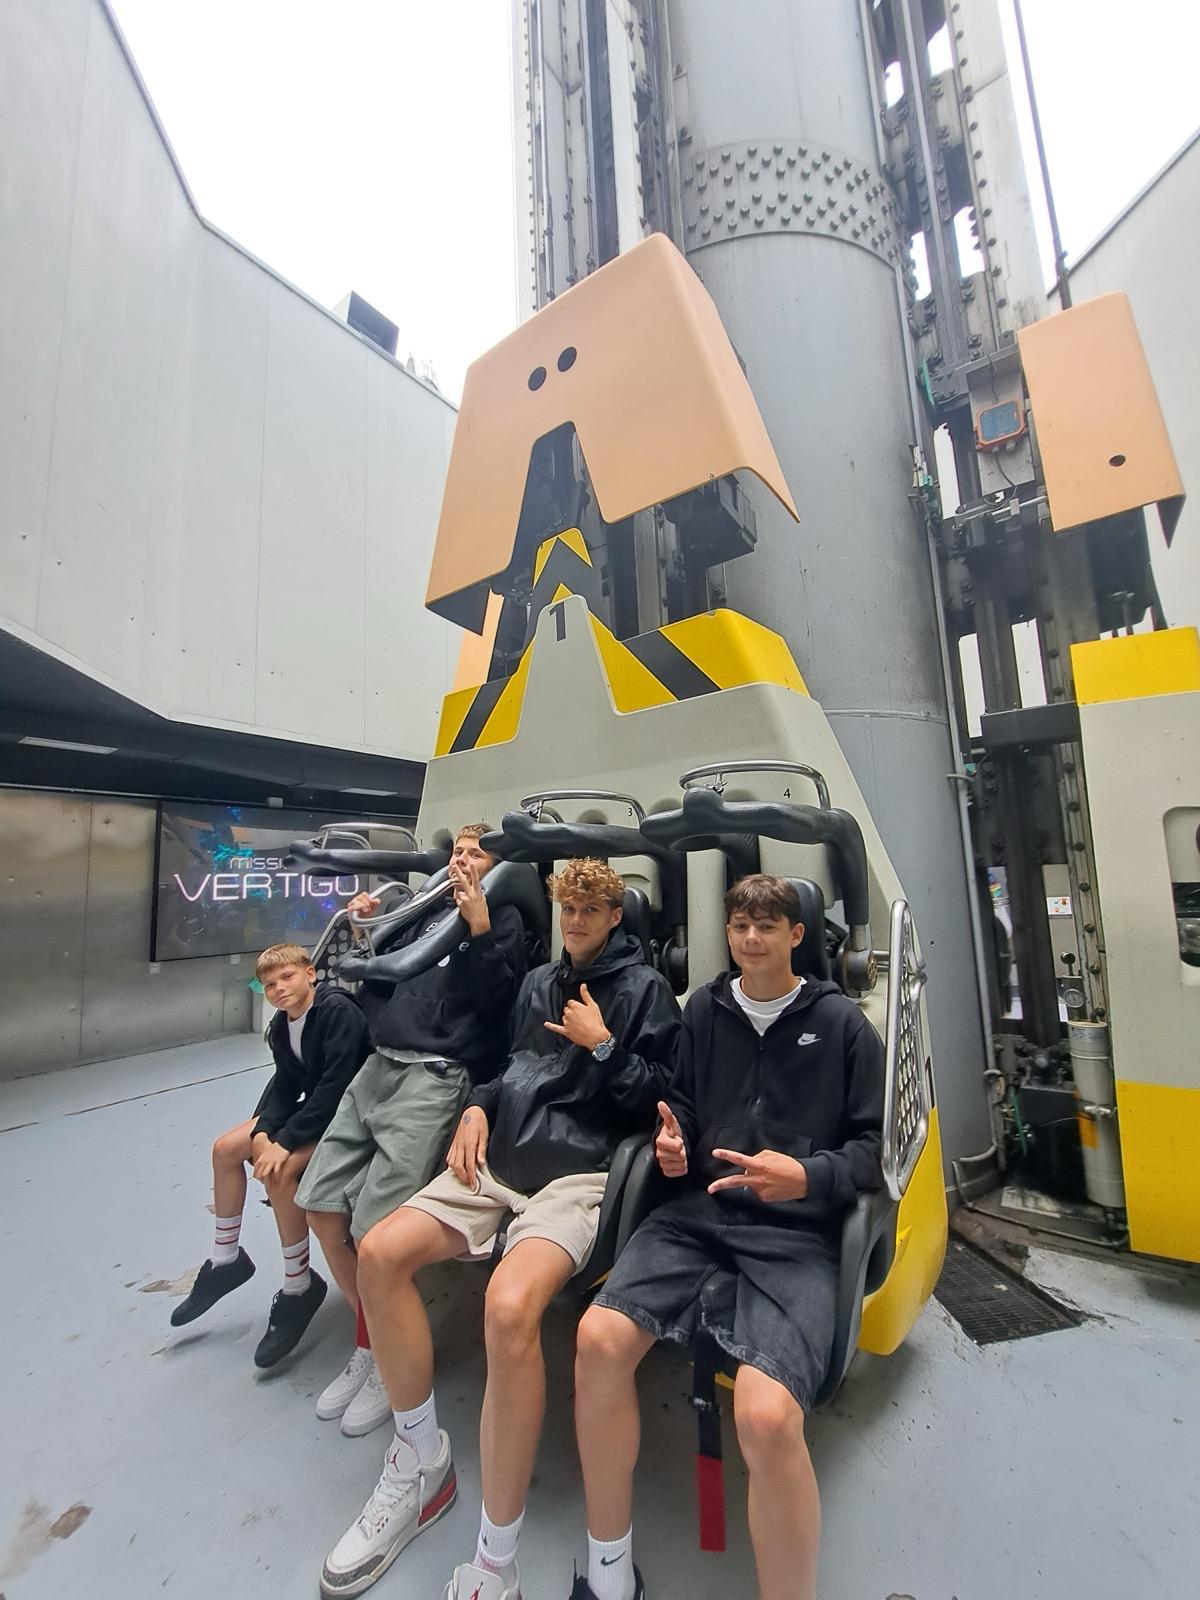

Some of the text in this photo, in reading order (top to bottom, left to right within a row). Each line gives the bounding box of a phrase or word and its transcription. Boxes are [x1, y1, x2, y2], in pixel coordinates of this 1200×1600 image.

[549, 601, 567, 642] 1
[783, 788, 791, 799] 4
[627, 807, 633, 817] 3
[230, 857, 287, 871] MISSI
[173, 872, 360, 902] VERTIGO
